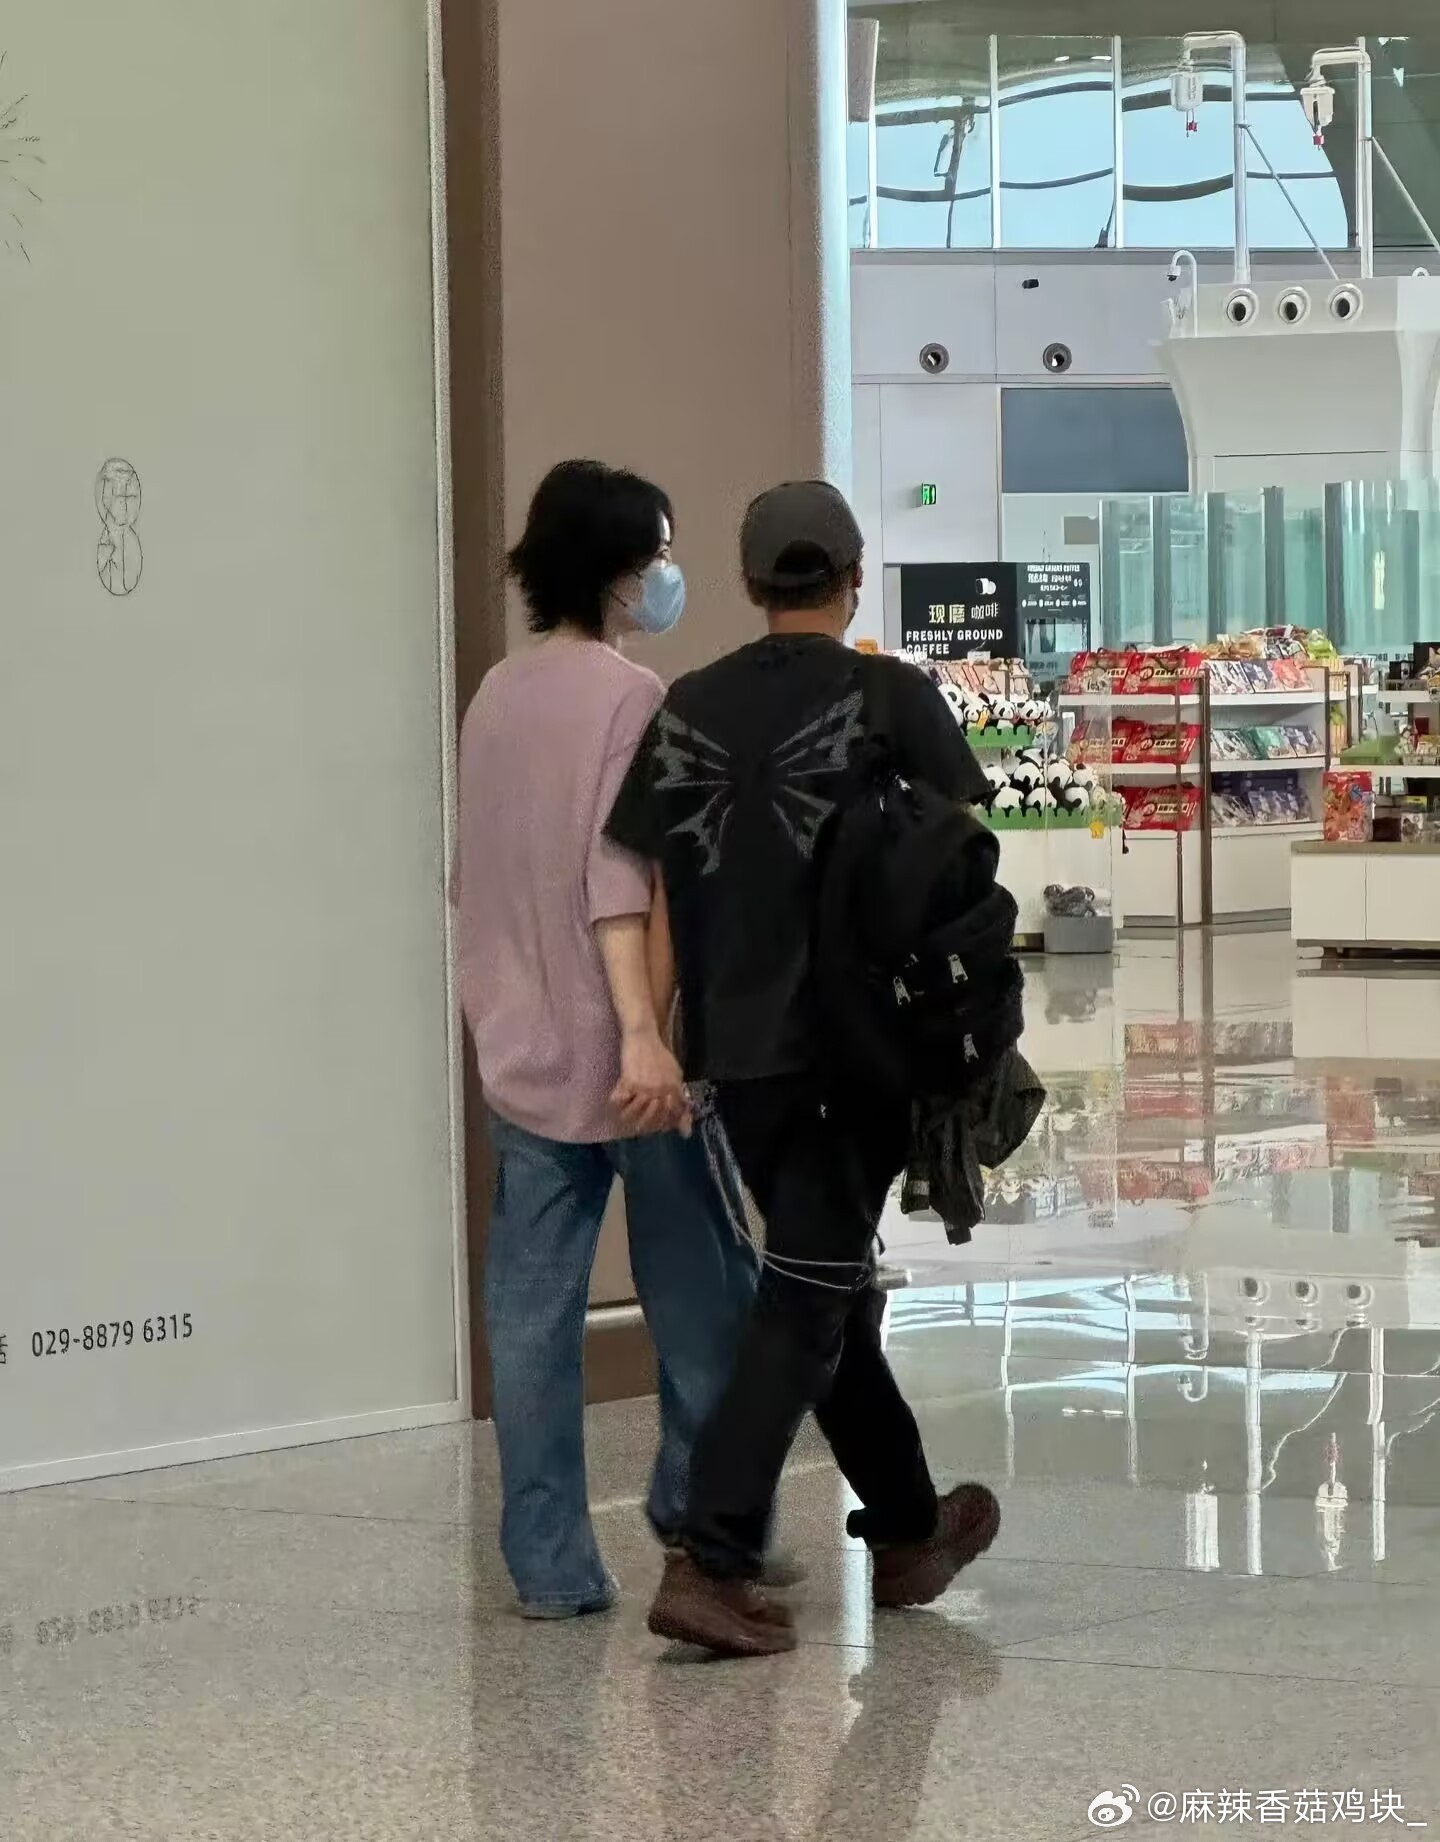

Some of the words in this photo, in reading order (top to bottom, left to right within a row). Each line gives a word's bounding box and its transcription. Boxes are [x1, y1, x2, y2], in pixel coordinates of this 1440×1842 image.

[971, 602, 999, 620] 咖啡
[906, 629, 954, 642] FRESHLY
[957, 629, 1003, 641] GROUND
[906, 643, 950, 655] COFFEE
[31, 1320, 134, 1357] 029-8879
[143, 1313, 193, 1343] 6315
